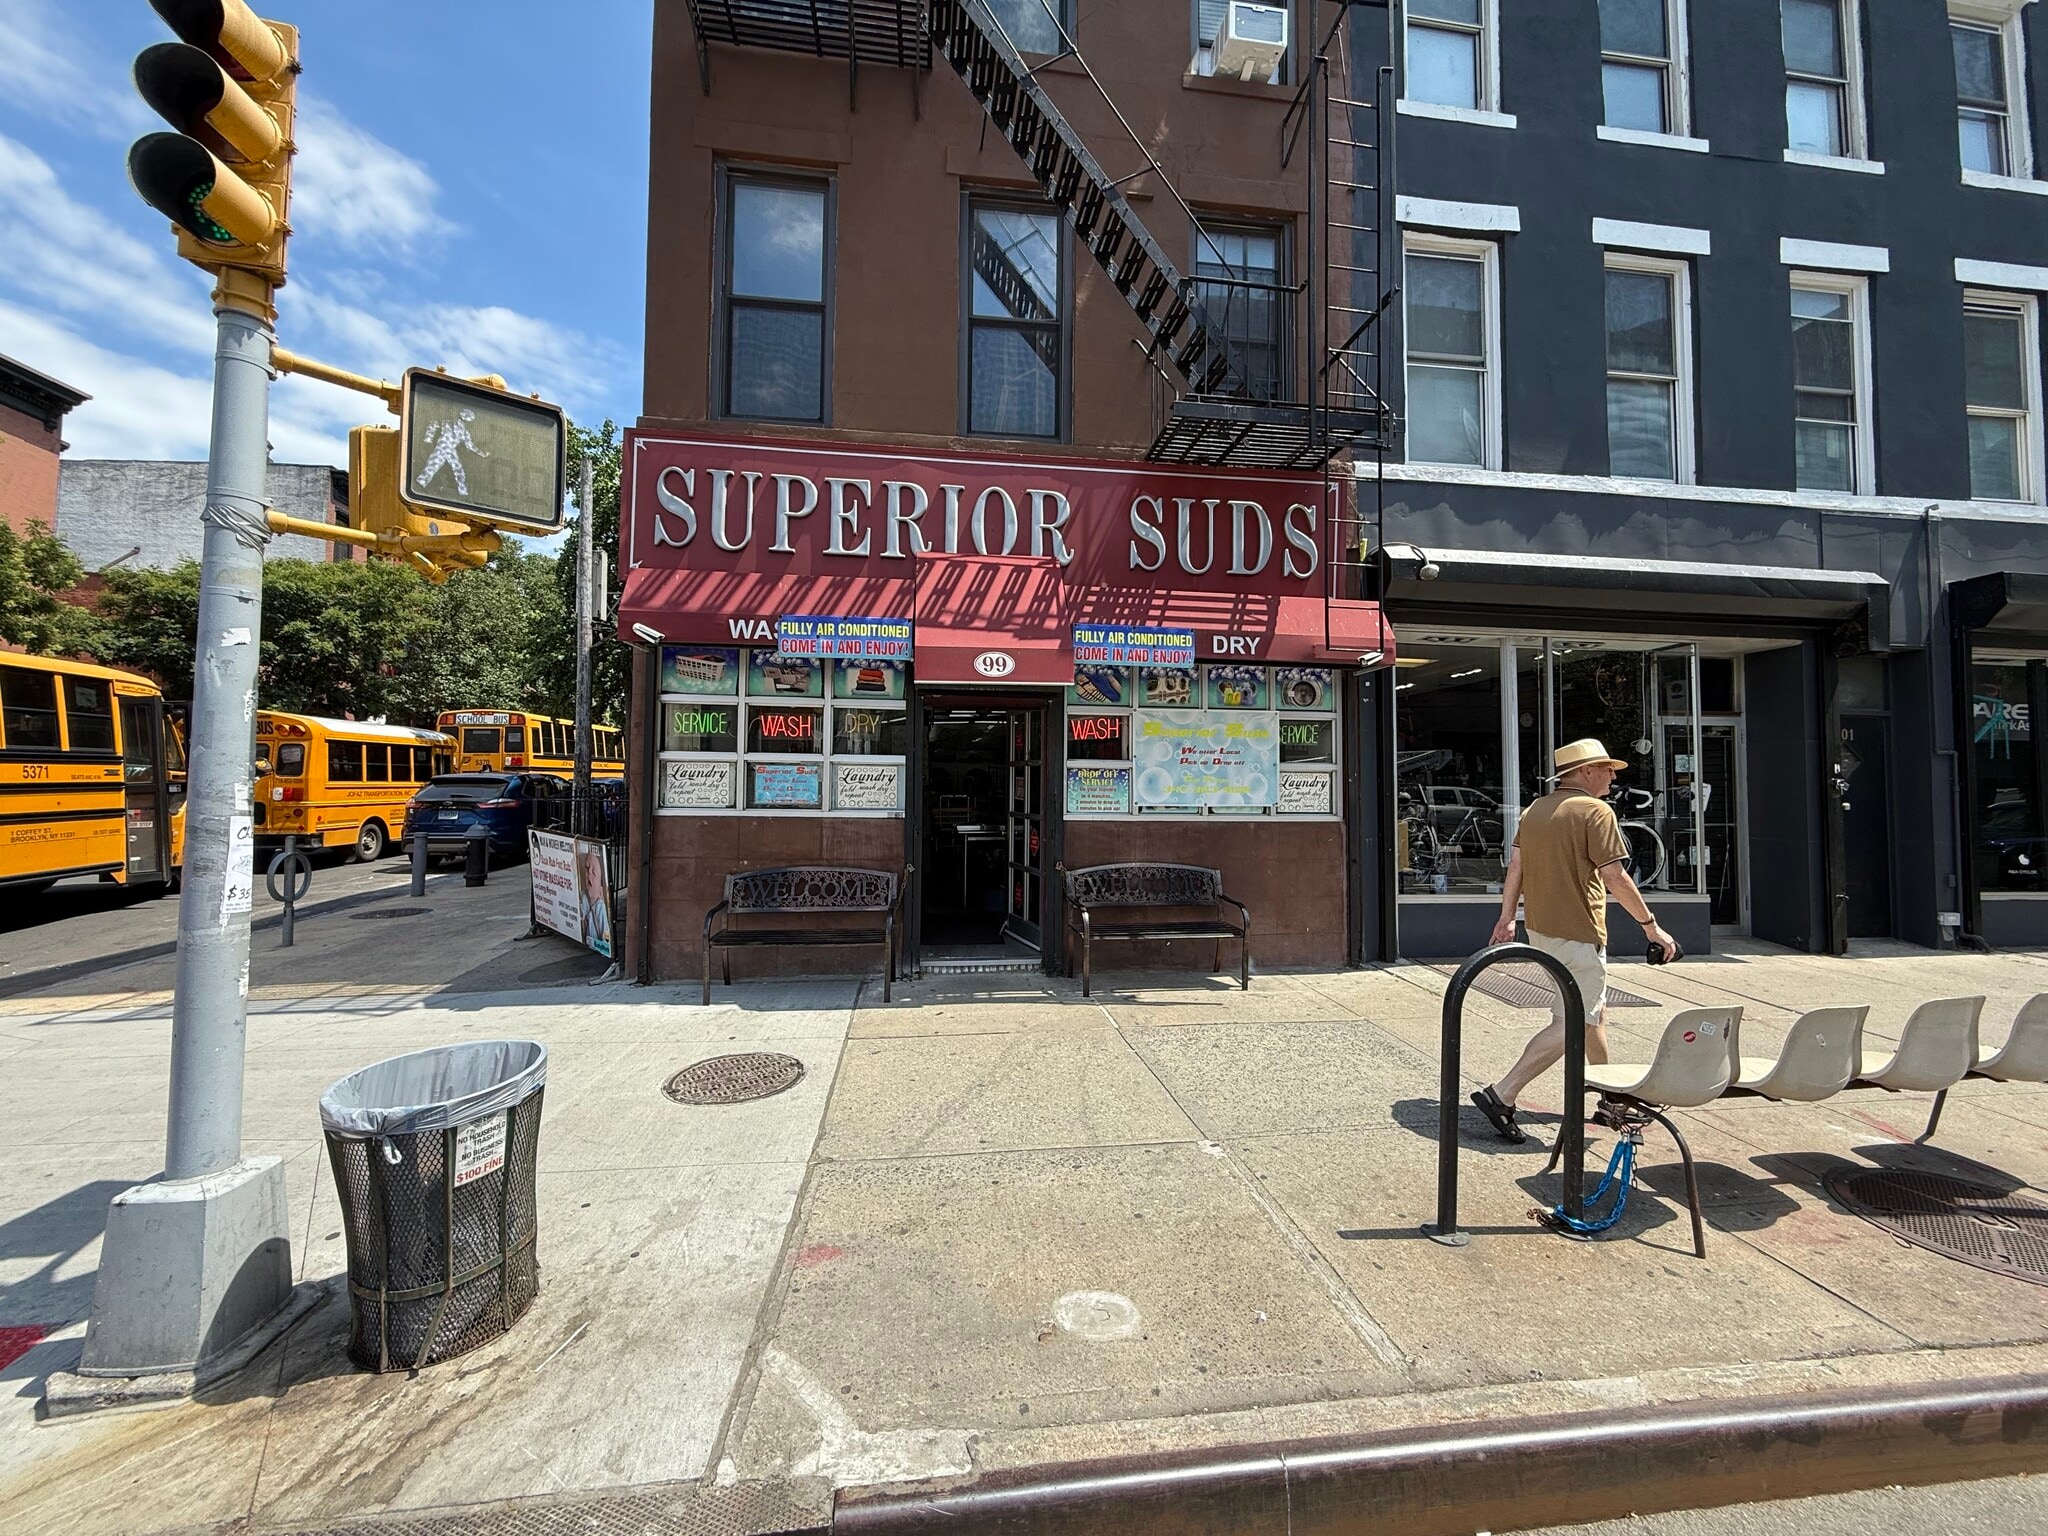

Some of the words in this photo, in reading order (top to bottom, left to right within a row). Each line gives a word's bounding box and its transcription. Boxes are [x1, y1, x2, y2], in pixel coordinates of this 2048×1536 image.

[654, 466, 1075, 567] SUPERIOR
[1129, 495, 1319, 579] SUDS
[780, 621, 813, 635] FULLY
[817, 623, 834, 636] AIR
[838, 623, 910, 638] CONDITIONED
[1075, 630, 1105, 643] FULLY
[1108, 632, 1125, 644] AIR
[1127, 633, 1192, 647] CONDITIONED
[1212, 635, 1261, 655] DRY
[781, 639, 816, 654] COME
[821, 640, 833, 653] IN
[838, 640, 861, 655] AND
[866, 641, 909, 656] ENJOY!
[1075, 646, 1107, 660] COME
[1112, 648, 1123, 661] IN
[1127, 648, 1149, 662] AND
[1153, 649, 1192, 664] ENJOY!
[982, 656, 1007, 672] 99
[456, 714, 488, 724] SCHOOL
[493, 714, 509, 724] BUS
[673, 712, 727, 734] SERVICE
[760, 715, 812, 737] WASH
[844, 713, 880, 734] DRY
[1071, 718, 1120, 740] WASH
[1278, 725, 1319, 744] ERVICE
[1181, 745, 1197, 755] We
[1219, 747, 1241, 755] Local
[1180, 757, 1197, 765] Pick
[1212, 758, 1232, 766] Drop
[22, 766, 49, 779] 5371
[668, 764, 728, 783] Laundry
[757, 766, 793, 775] Superior
[796, 766, 818, 775] Suds
[839, 767, 896, 786] Laundry
[1078, 770, 1101, 779] DROP
[1103, 770, 1119, 778] OFF
[669, 781, 687, 792] fold
[689, 778, 707, 787] wash
[707, 780, 720, 791] dry
[840, 785, 857, 795] fold
[859, 783, 877, 791] wash
[876, 784, 889, 795] dry
[1082, 778, 1114, 786] SERVICE
[1279, 774, 1328, 792] Laundry
[673, 788, 695, 797] repeat
[844, 791, 866, 800] repeat
[1280, 790, 1294, 801] fold
[1296, 788, 1311, 796] wash
[1311, 790, 1322, 800] dry
[10, 834, 47, 843] BROOKLYN,
[15, 829, 41, 837] COFFEY
[227, 885, 237, 901] $
[238, 888, 252, 900] 35
[751, 881, 876, 900] WELCOME
[1087, 877, 1201, 894] WELCOME
[458, 1136, 468, 1145] NO
[469, 1121, 506, 1141] HOUSEHOLD
[473, 1134, 494, 1146] TRASH
[461, 1151, 472, 1161] NO
[473, 1138, 504, 1156] BUSINESS
[472, 1150, 494, 1163] TRASH
[456, 1166, 482, 1183] $100
[483, 1155, 504, 1172] FINE
